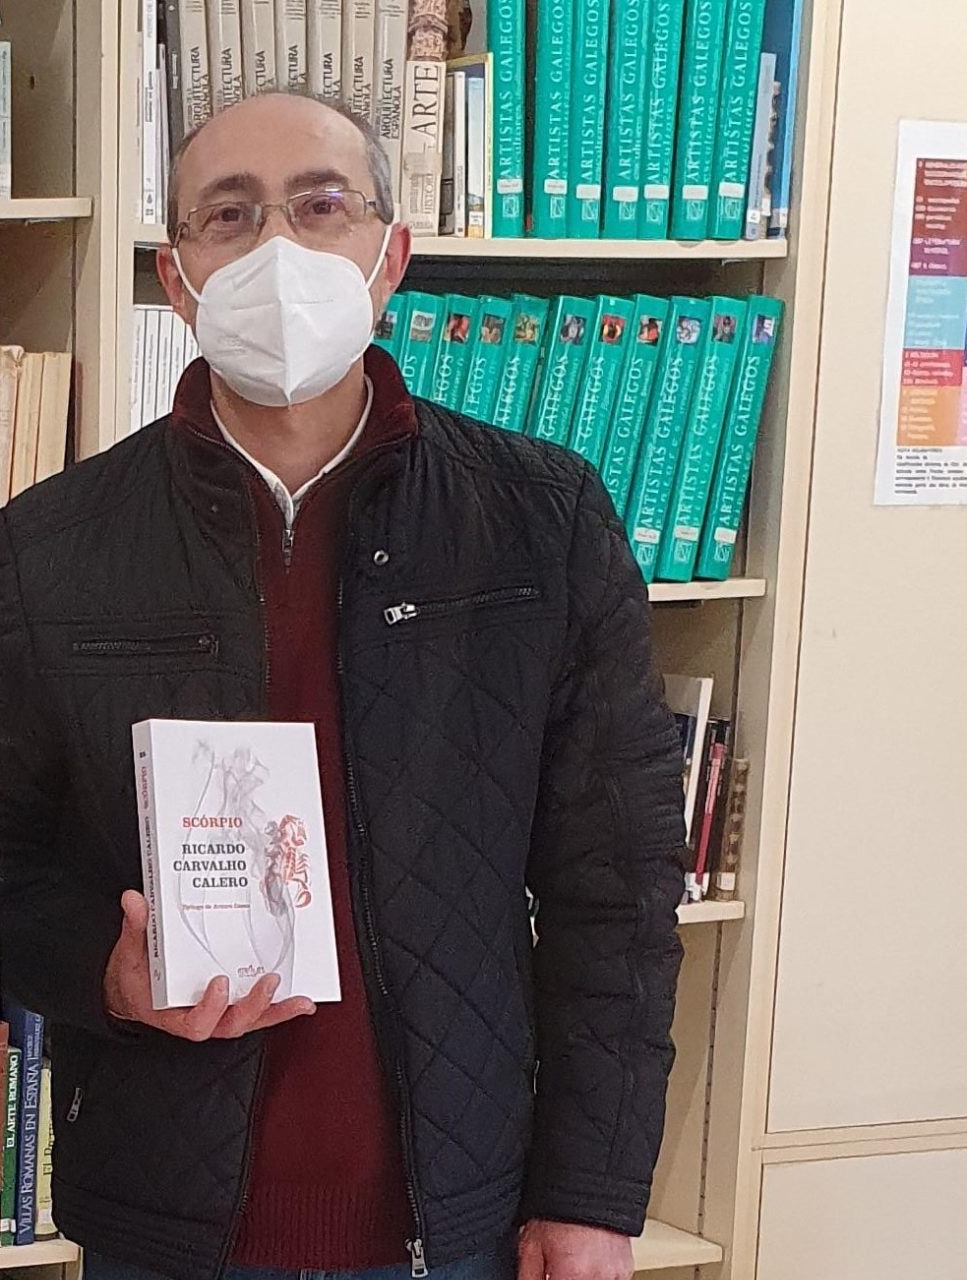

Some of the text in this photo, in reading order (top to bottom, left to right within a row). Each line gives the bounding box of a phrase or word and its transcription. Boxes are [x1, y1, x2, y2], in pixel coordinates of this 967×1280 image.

[381, 58, 394, 139] ARQUITECTURA
[390, 86, 402, 140] ESPAÑOLA
[410, 64, 439, 137] ARTE
[580, 0, 600, 183] ARTISTAS GALEGOS
[646, 3, 670, 184] ARTISTAS GALEGOS
[687, 1, 712, 183] ARTISTAS GALEGOS
[724, 2, 753, 183] ARTISTAS GALEGOS
[499, 91, 513, 179] ARTISTAS
[547, 91, 561, 179] ARTISTAS
[618, 94, 634, 180] ARTISTAS
[421, 174, 434, 214] HISTORI
[466, 357, 488, 415] LEGOS
[496, 356, 521, 424] ALEGOS
[542, 355, 569, 437] GALEGOS
[581, 356, 605, 438] GALEGOS
[617, 357, 643, 438] GALEGOS
[639, 357, 683, 528] ARTISTAS GALEGOS
[676, 354, 719, 525] ARTISTAS GALEGOS
[719, 355, 760, 526] ARTISTAS GALEGOS
[182, 815, 243, 829] SCÓRPIO
[182, 844, 245, 855] RICARDO
[173, 860, 247, 872] CARVALHO
[192, 877, 249, 888] CALERO
[6, 1054, 19, 1148] EL ARTE ROMANO
[25, 1063, 40, 1109] ESPAÑA
[26, 1114, 37, 1130] EN
[21, 1133, 36, 1194] ROMANAS
[19, 1196, 33, 1235] VILLAS
